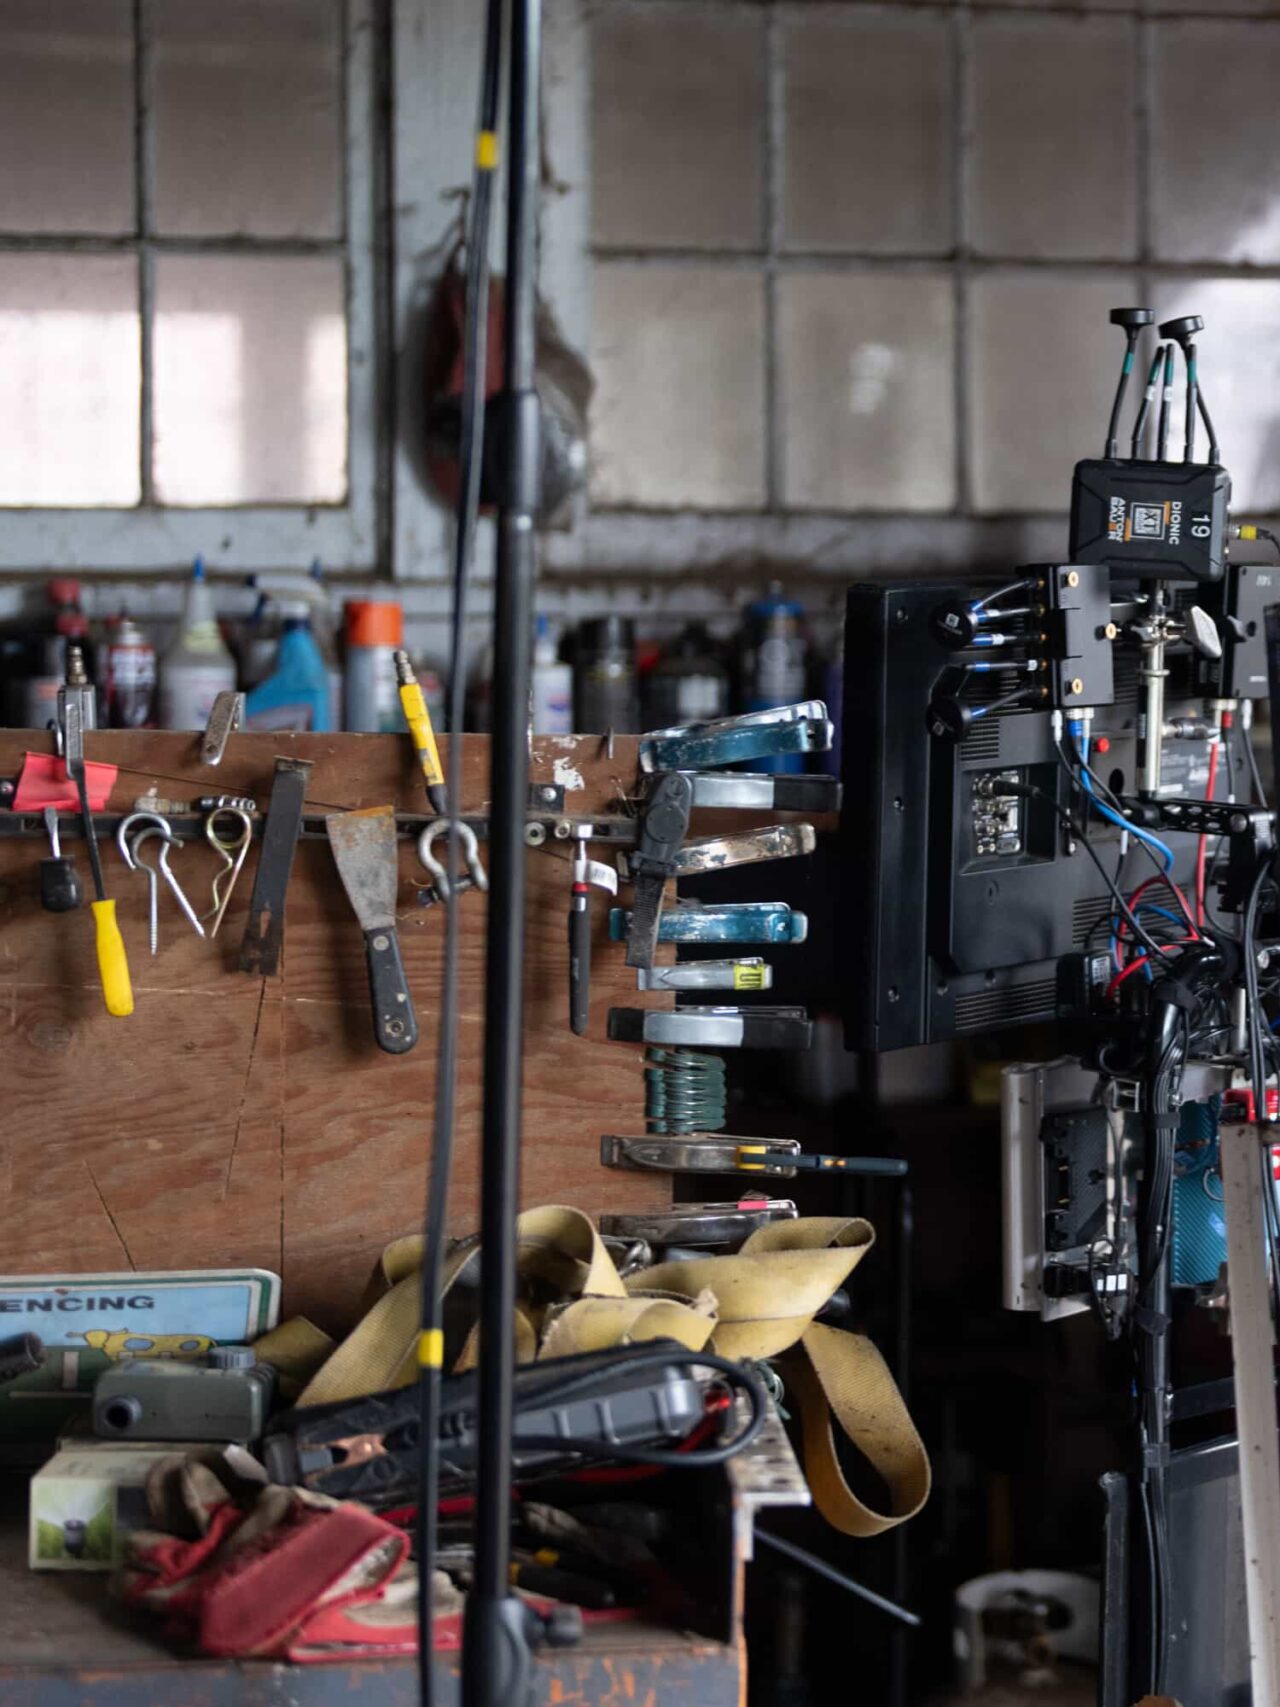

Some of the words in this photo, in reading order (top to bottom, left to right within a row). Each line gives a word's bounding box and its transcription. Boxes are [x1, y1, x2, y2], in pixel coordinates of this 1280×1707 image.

[1168, 501, 1182, 545] DIONIC
[1191, 515, 1211, 538] 19
[0, 1295, 155, 1313] ENCING
